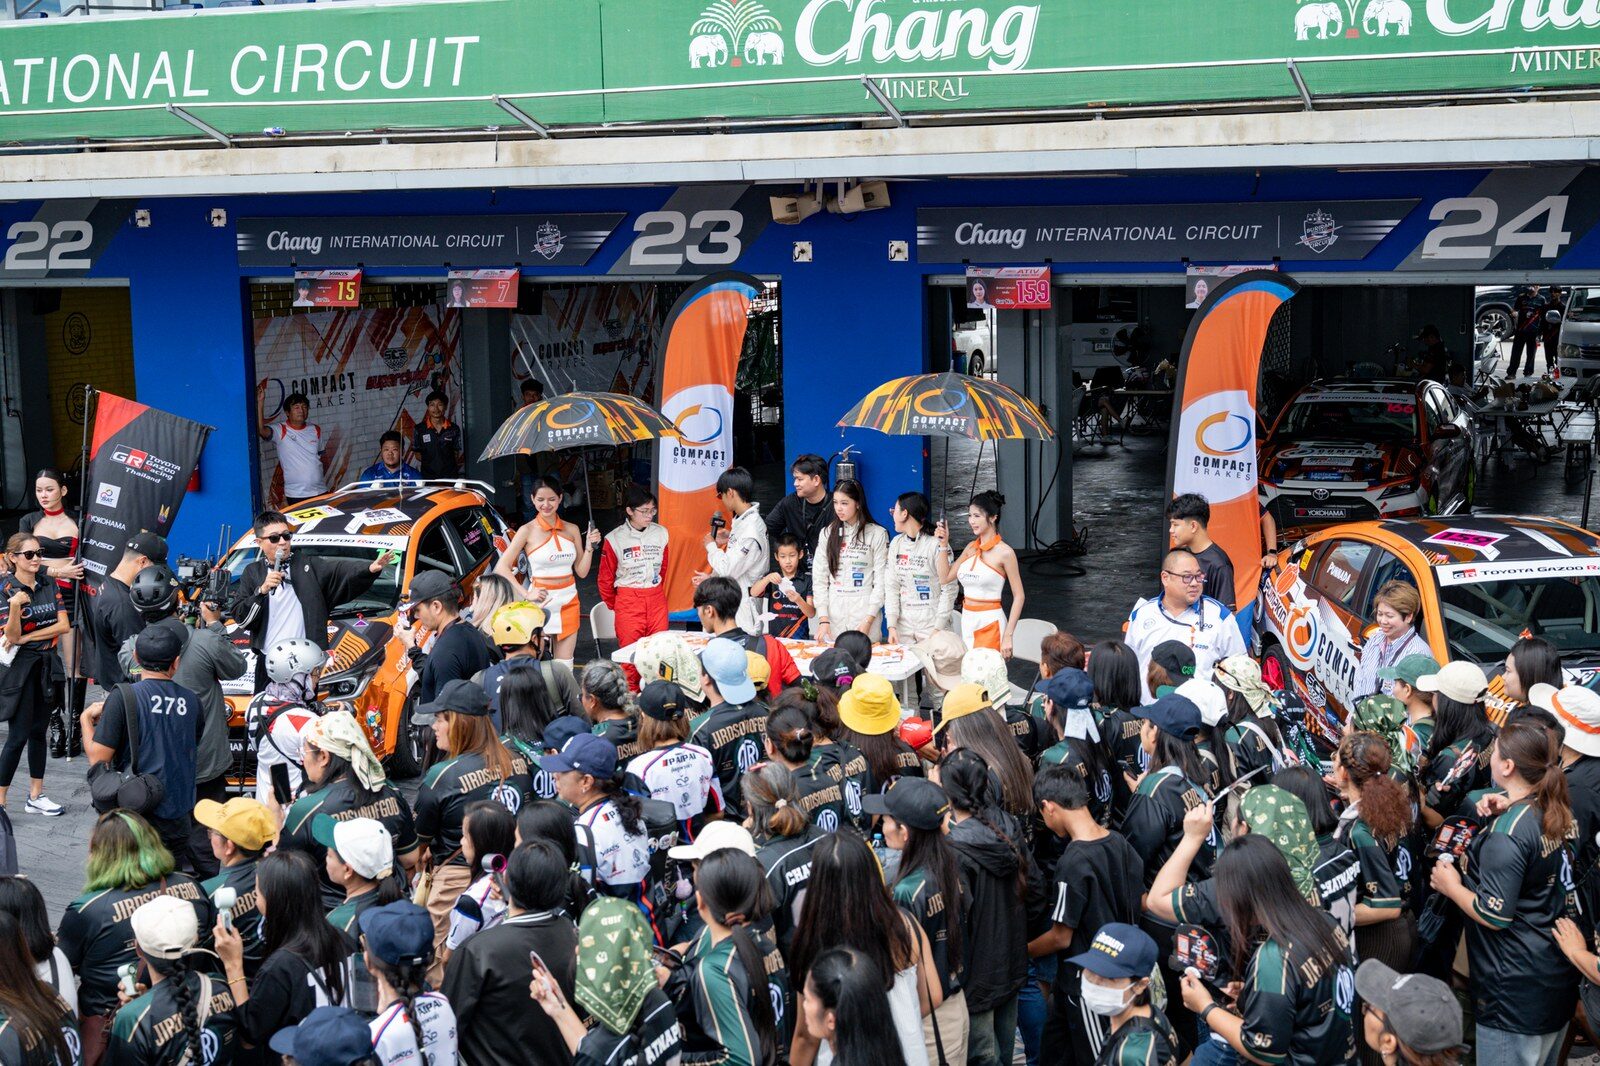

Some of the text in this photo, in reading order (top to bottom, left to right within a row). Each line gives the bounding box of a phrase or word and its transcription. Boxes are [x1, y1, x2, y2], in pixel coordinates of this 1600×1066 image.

[794, 0, 1041, 71] Chang
[1510, 46, 1600, 73] MINER
[0, 36, 481, 104] TIONAL CIRCUIT
[865, 76, 970, 102] MINERAL
[954, 222, 1262, 249] Chang INTERNATIONAL CIRCUIT
[1422, 195, 1570, 259] 24
[4, 221, 94, 270] 22
[266, 230, 505, 254] Chang INTERNATIONAL CIRCUIT
[629, 210, 744, 266] 23
[338, 281, 356, 301] 15
[498, 280, 510, 302] 7
[1016, 280, 1050, 303] 159
[538, 340, 585, 360] COMPACT
[292, 372, 355, 396] COMPACT
[309, 392, 357, 408] AKES
[912, 416, 967, 427] COMPACT
[912, 424, 966, 432] BRAKES
[547, 425, 600, 439] COMPACT
[547, 432, 600, 443] BRAKES
[112, 451, 143, 468] GR
[673, 446, 726, 460] COMPACT
[145, 460, 176, 475] GAZOO
[149, 454, 181, 471] TOYOTA
[673, 457, 726, 468] BRAKES
[1193, 456, 1253, 473] COMPACT
[125, 467, 161, 484] Thailand
[143, 465, 173, 480] Racing
[1193, 467, 1252, 481] BRAKES
[1307, 509, 1344, 517] YOKOHAMA
[90, 516, 126, 531] YOKOHAMA
[1480, 568, 1535, 576] TOYOTA
[1318, 633, 1357, 691] COMPA
[151, 695, 187, 716] 278
[711, 716, 768, 750] JIRDSONOFGO
[1487, 897, 1504, 912] 95
[1253, 1032, 1274, 1048] 95
